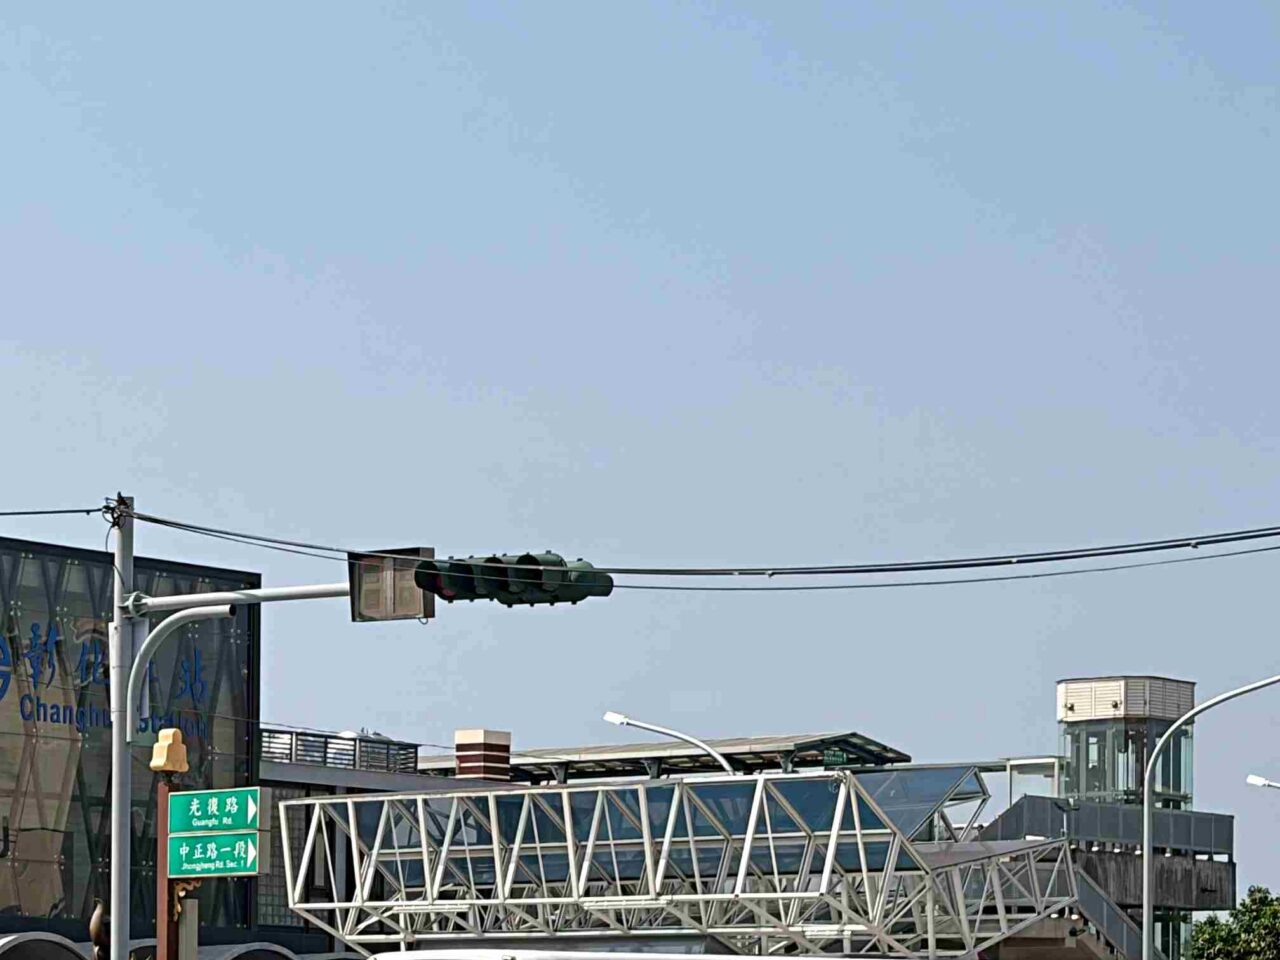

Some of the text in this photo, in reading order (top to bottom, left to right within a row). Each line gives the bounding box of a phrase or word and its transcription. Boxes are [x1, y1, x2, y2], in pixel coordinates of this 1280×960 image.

[21, 622, 209, 701] 彰化站
[189, 796, 238, 816] 光復路
[179, 841, 247, 861] 中正路一段
